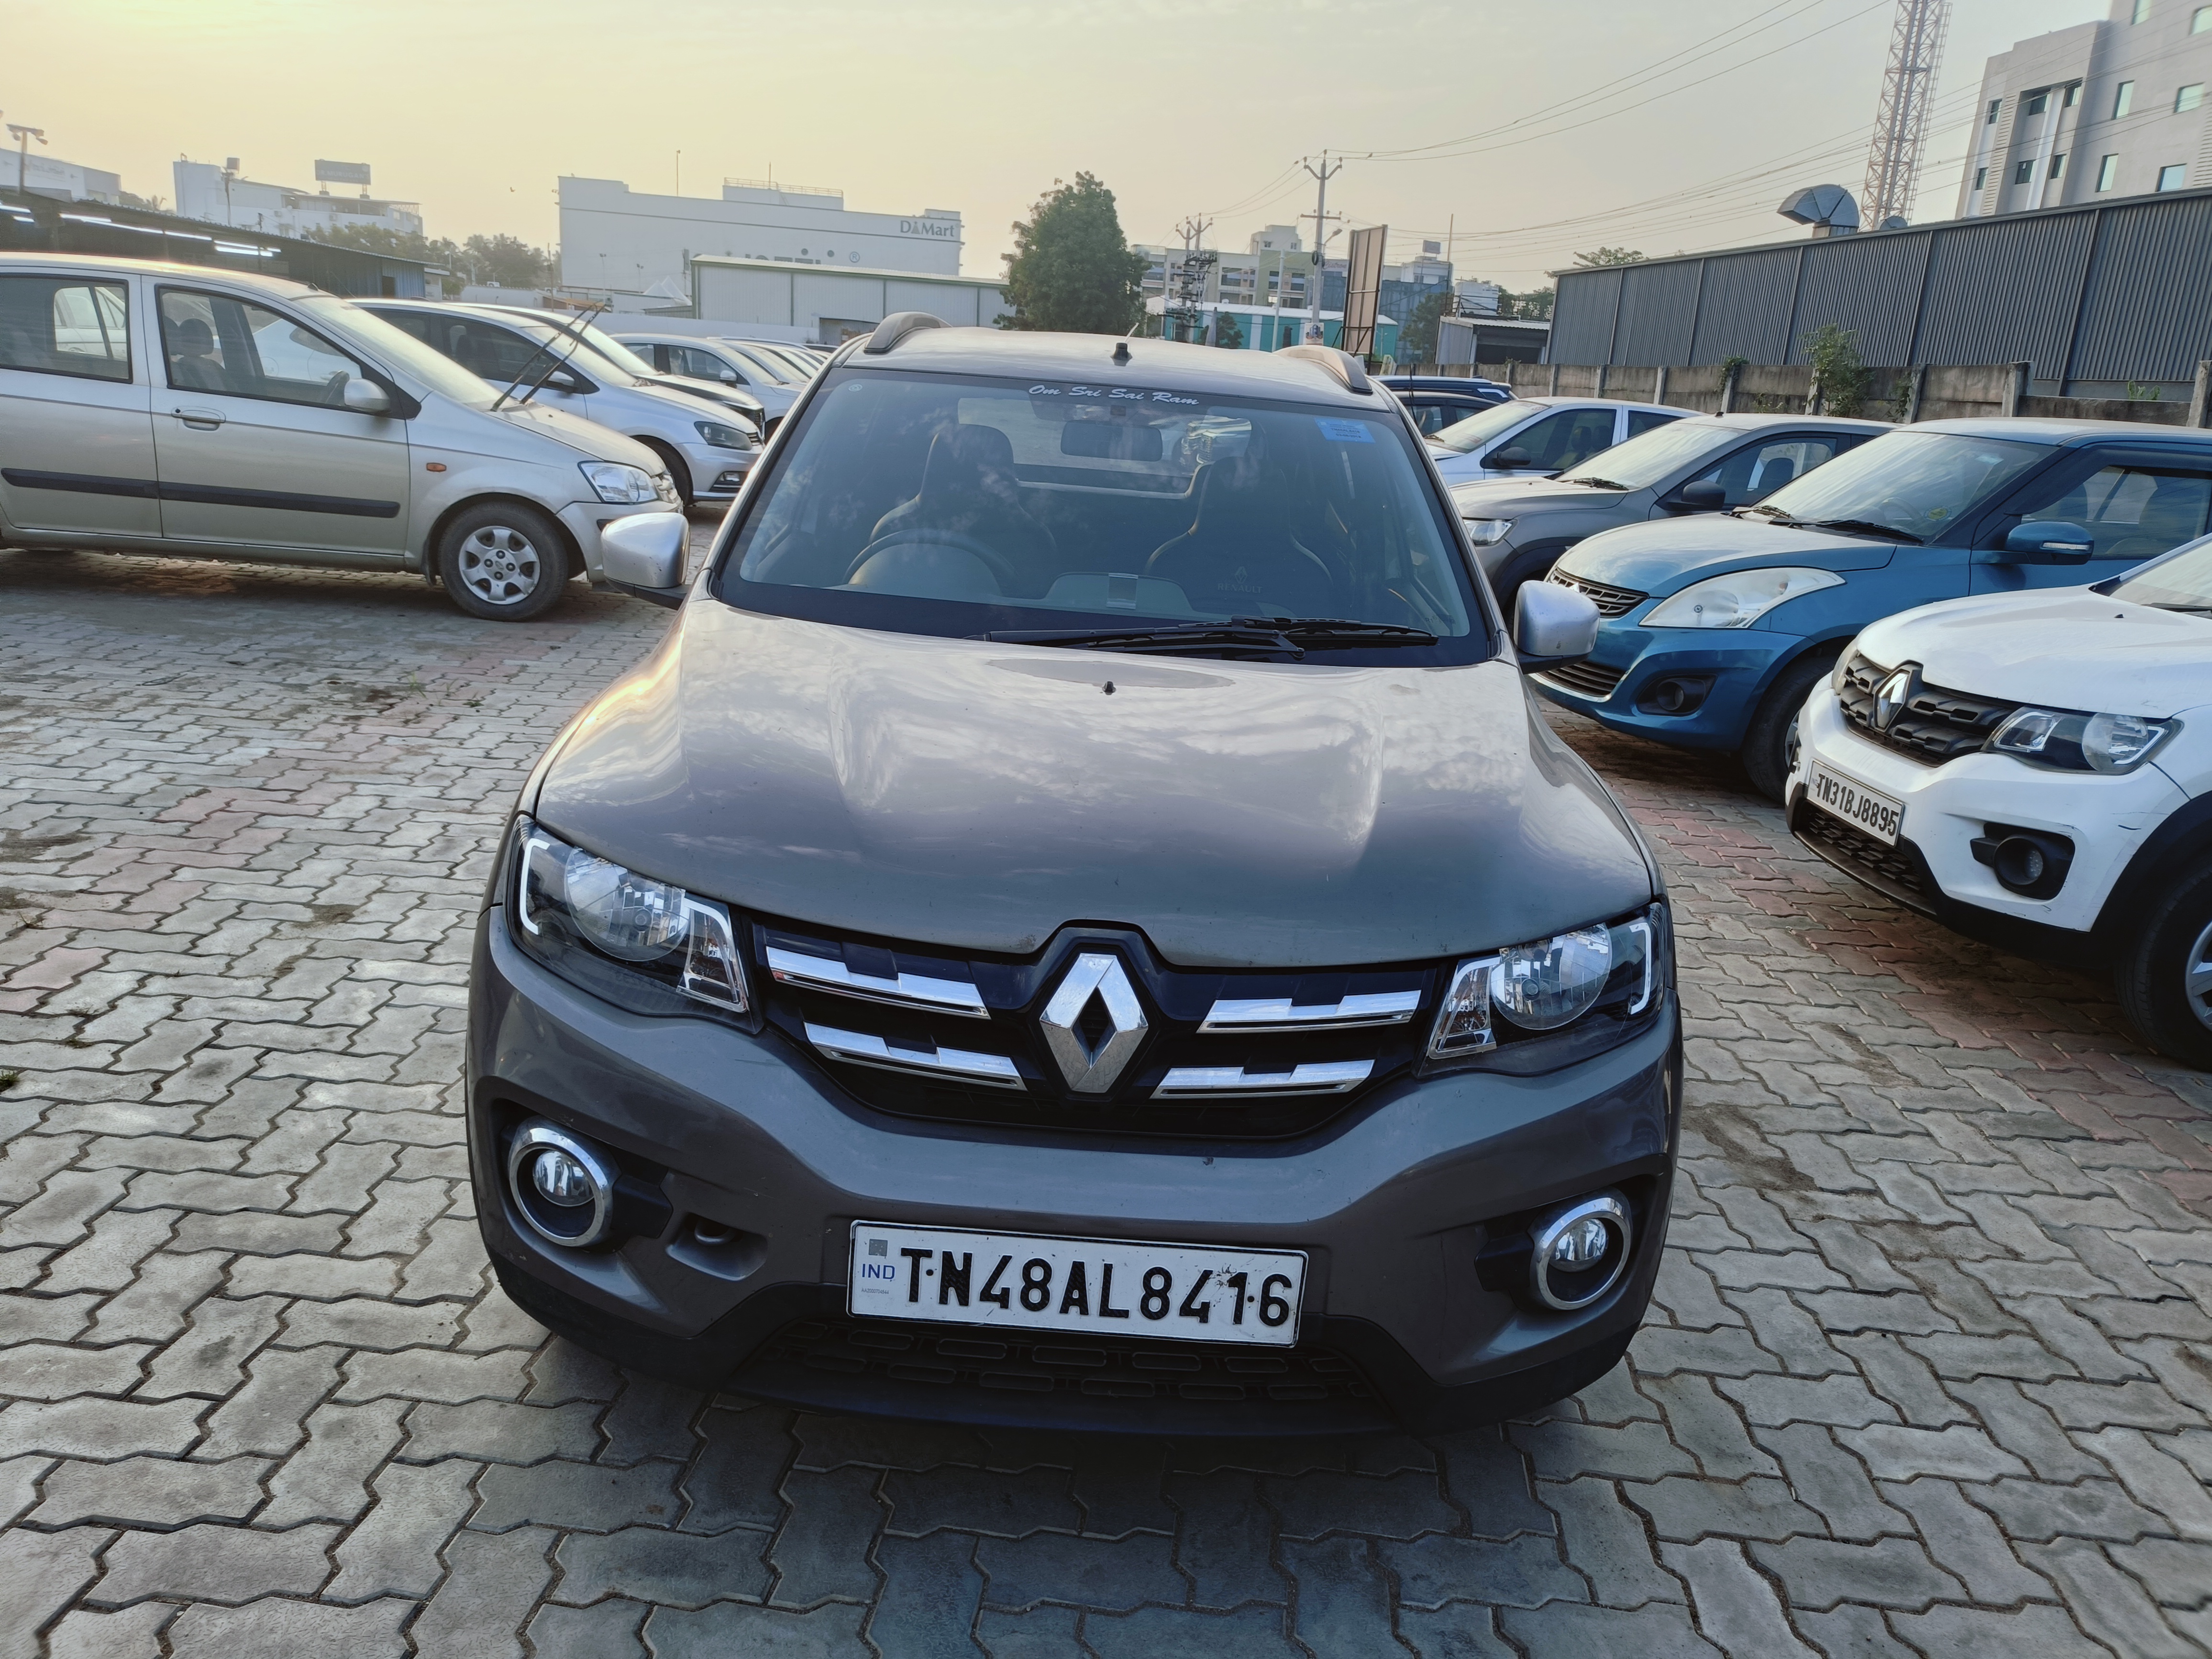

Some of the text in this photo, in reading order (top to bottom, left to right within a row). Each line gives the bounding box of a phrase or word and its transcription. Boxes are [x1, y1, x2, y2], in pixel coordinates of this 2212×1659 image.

[1029, 385, 1199, 405] Om Sri Sai Ram
[1217, 583, 1263, 593] RENAULT
[1817, 773, 1899, 837] TN31BJ8895
[862, 1263, 895, 1280] IND
[900, 1247, 1293, 1327] TN48AL8416
